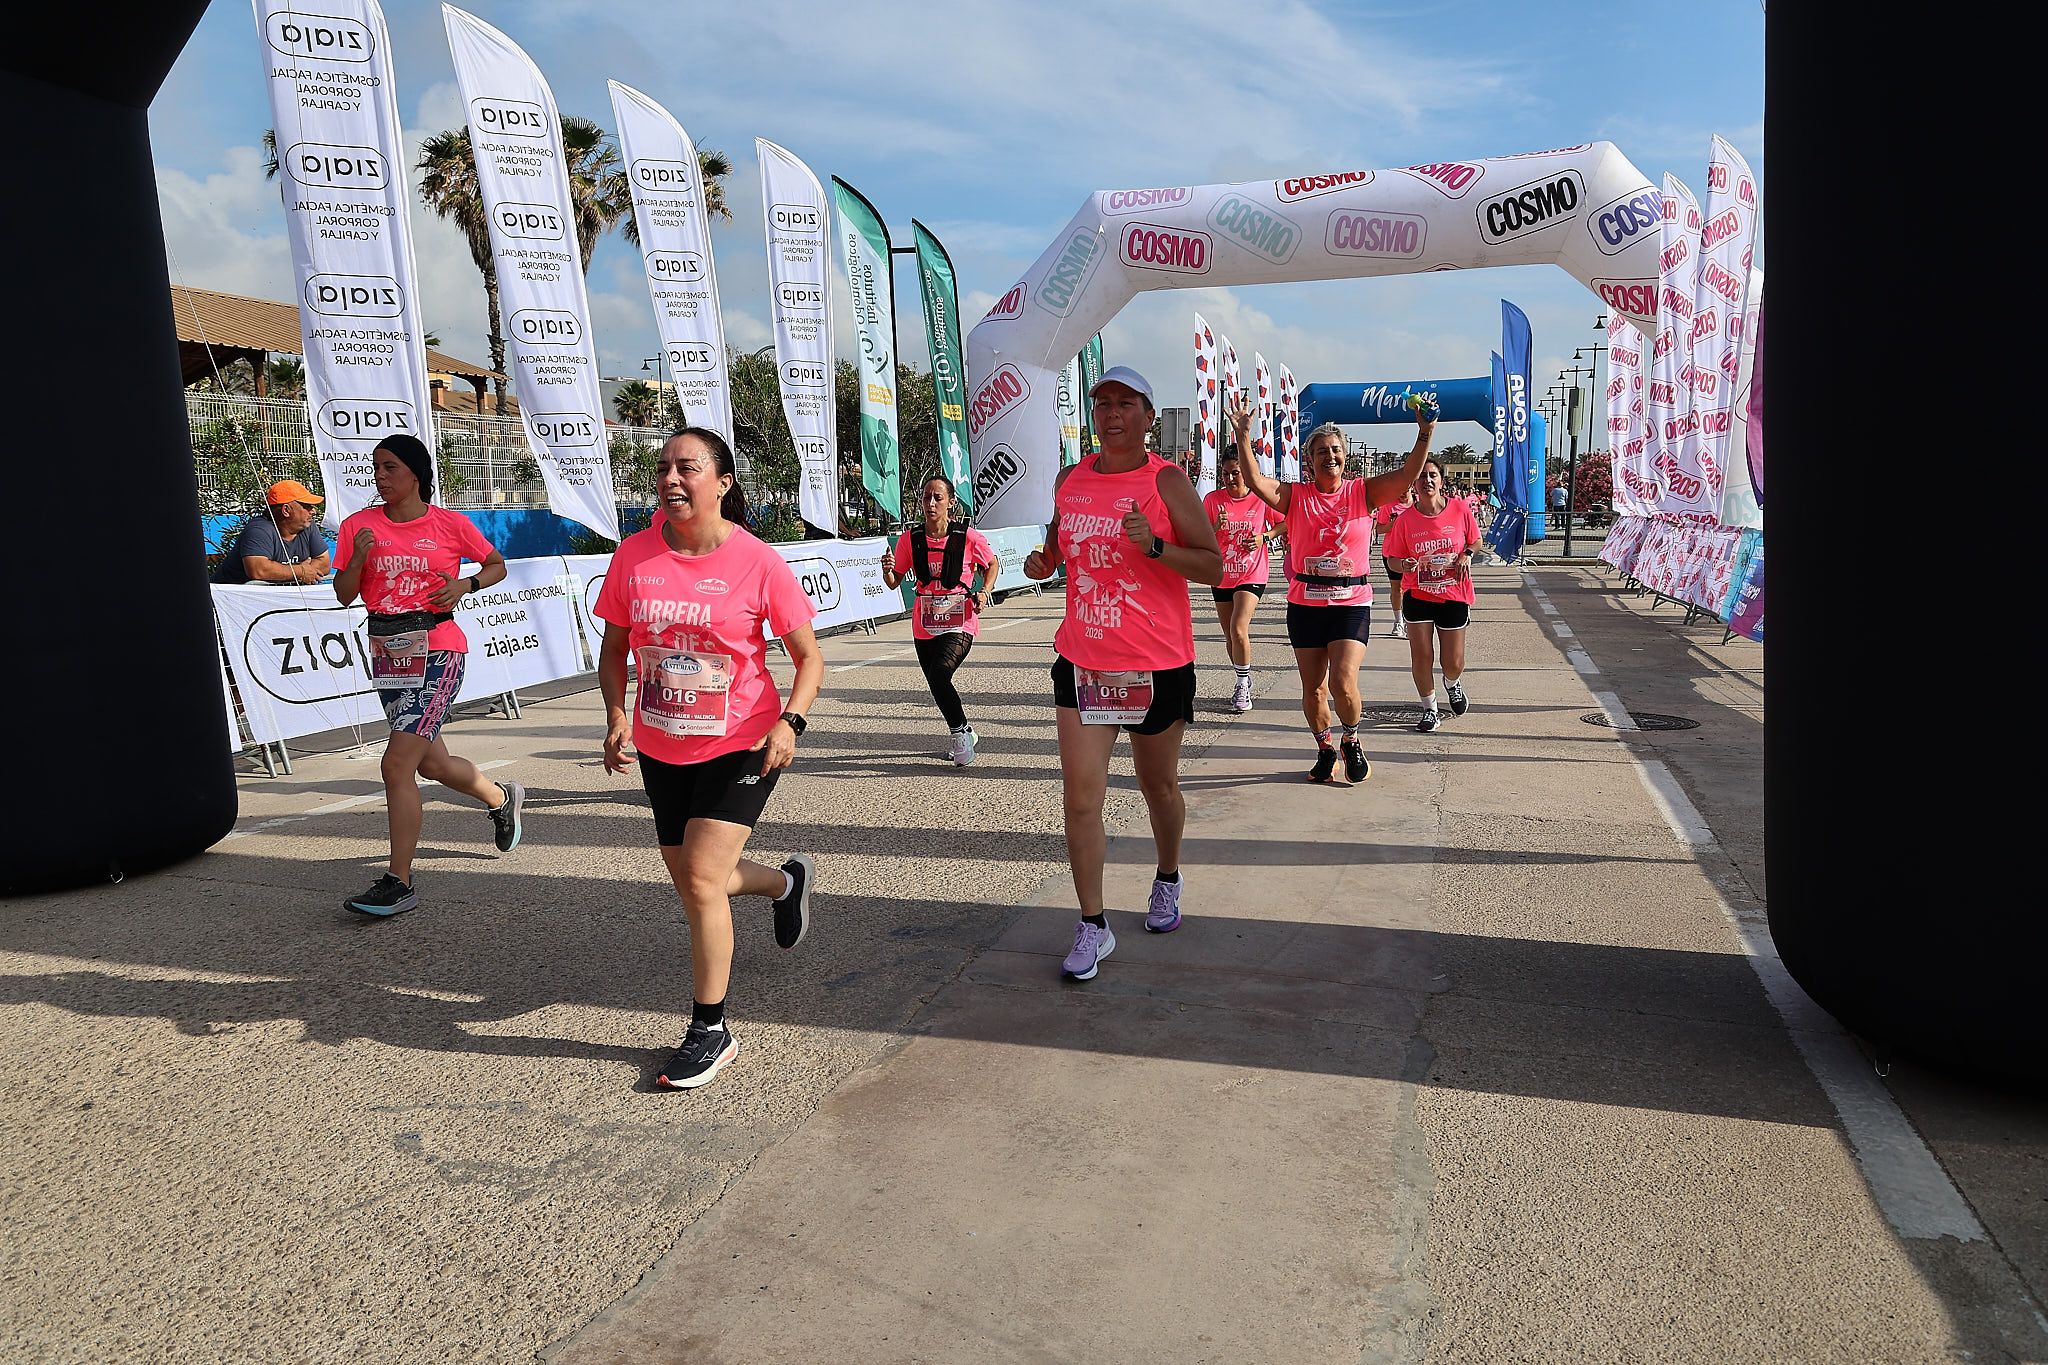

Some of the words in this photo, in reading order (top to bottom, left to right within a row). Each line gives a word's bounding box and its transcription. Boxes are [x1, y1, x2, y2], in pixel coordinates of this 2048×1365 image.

[1283, 170, 1367, 196] COSMO
[1109, 187, 1186, 210] COSMO
[1486, 176, 1578, 237] COSMO
[1215, 198, 1294, 258] COSMO
[1598, 190, 1664, 246] COSM
[1333, 215, 1419, 254] COSMO
[1128, 228, 1205, 269] COSMO
[1041, 233, 1100, 310] COSMO
[1599, 283, 1659, 316] COSM
[969, 370, 1023, 434] COSMO
[1064, 495, 1092, 505] OYSHO
[1060, 512, 1123, 539] CARRERA
[1088, 542, 1114, 569] DE
[1414, 537, 1454, 554] CARRERA
[375, 555, 430, 573] ARRERA
[629, 576, 665, 586] OYSHO
[802, 570, 833, 606] aja
[481, 591, 518, 608] FACIAL,
[518, 584, 566, 602] CORPORAL
[1093, 586, 1110, 605] LA
[476, 617, 485, 629] Y
[487, 610, 528, 628] CAPILAR
[631, 599, 712, 629] CARRERA
[933, 613, 951, 621] 016
[1073, 596, 1123, 629] MUJER
[484, 633, 540, 658] ziaja.es
[1084, 626, 1104, 640] 2026
[272, 628, 372, 681] ziaj
[393, 656, 412, 668] 016
[663, 660, 699, 672] ASTURIANA
[662, 687, 697, 704] 016
[1100, 686, 1128, 699] 016
